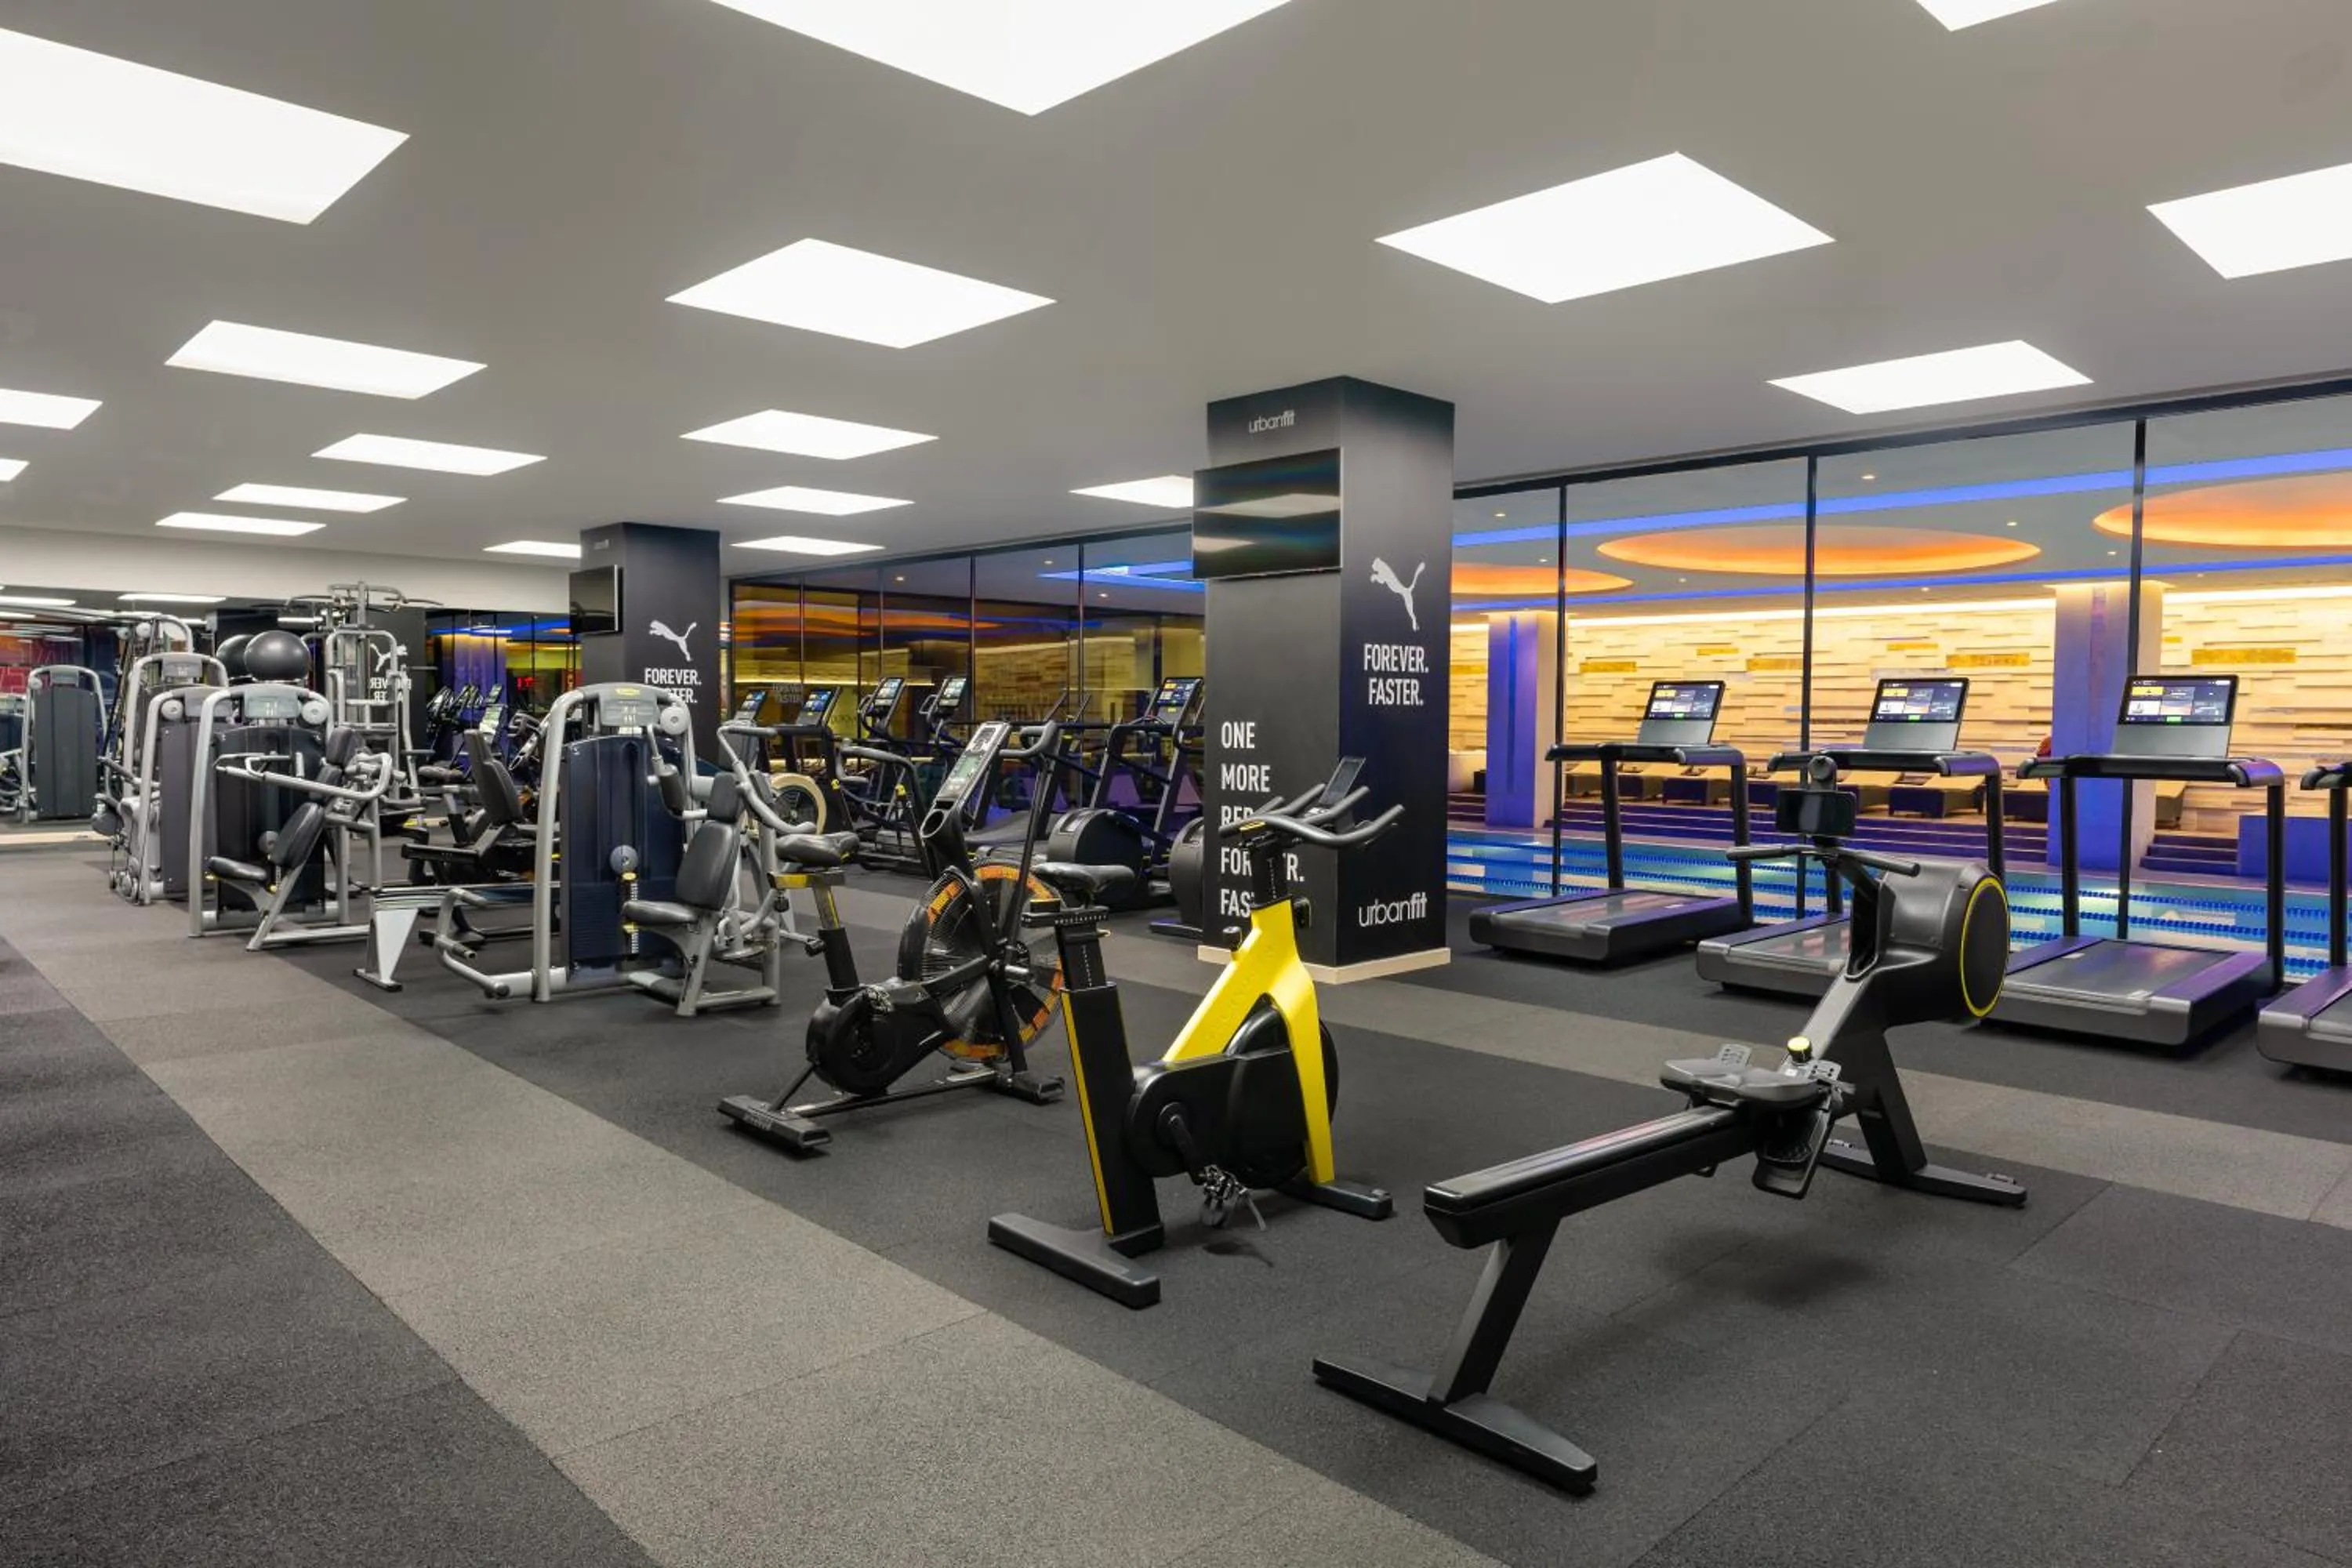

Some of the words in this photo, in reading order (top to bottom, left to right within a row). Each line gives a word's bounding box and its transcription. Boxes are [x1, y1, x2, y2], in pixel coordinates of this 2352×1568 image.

[1363, 643, 1429, 673] FOREVER.
[644, 667, 702, 685] FOREVER.
[1368, 677, 1424, 706] FASTER.
[1221, 720, 1256, 750] ONE
[1221, 763, 1271, 793] MORE
[1220, 888, 1255, 918] FAS
[1359, 891, 1428, 927] urbanfit
